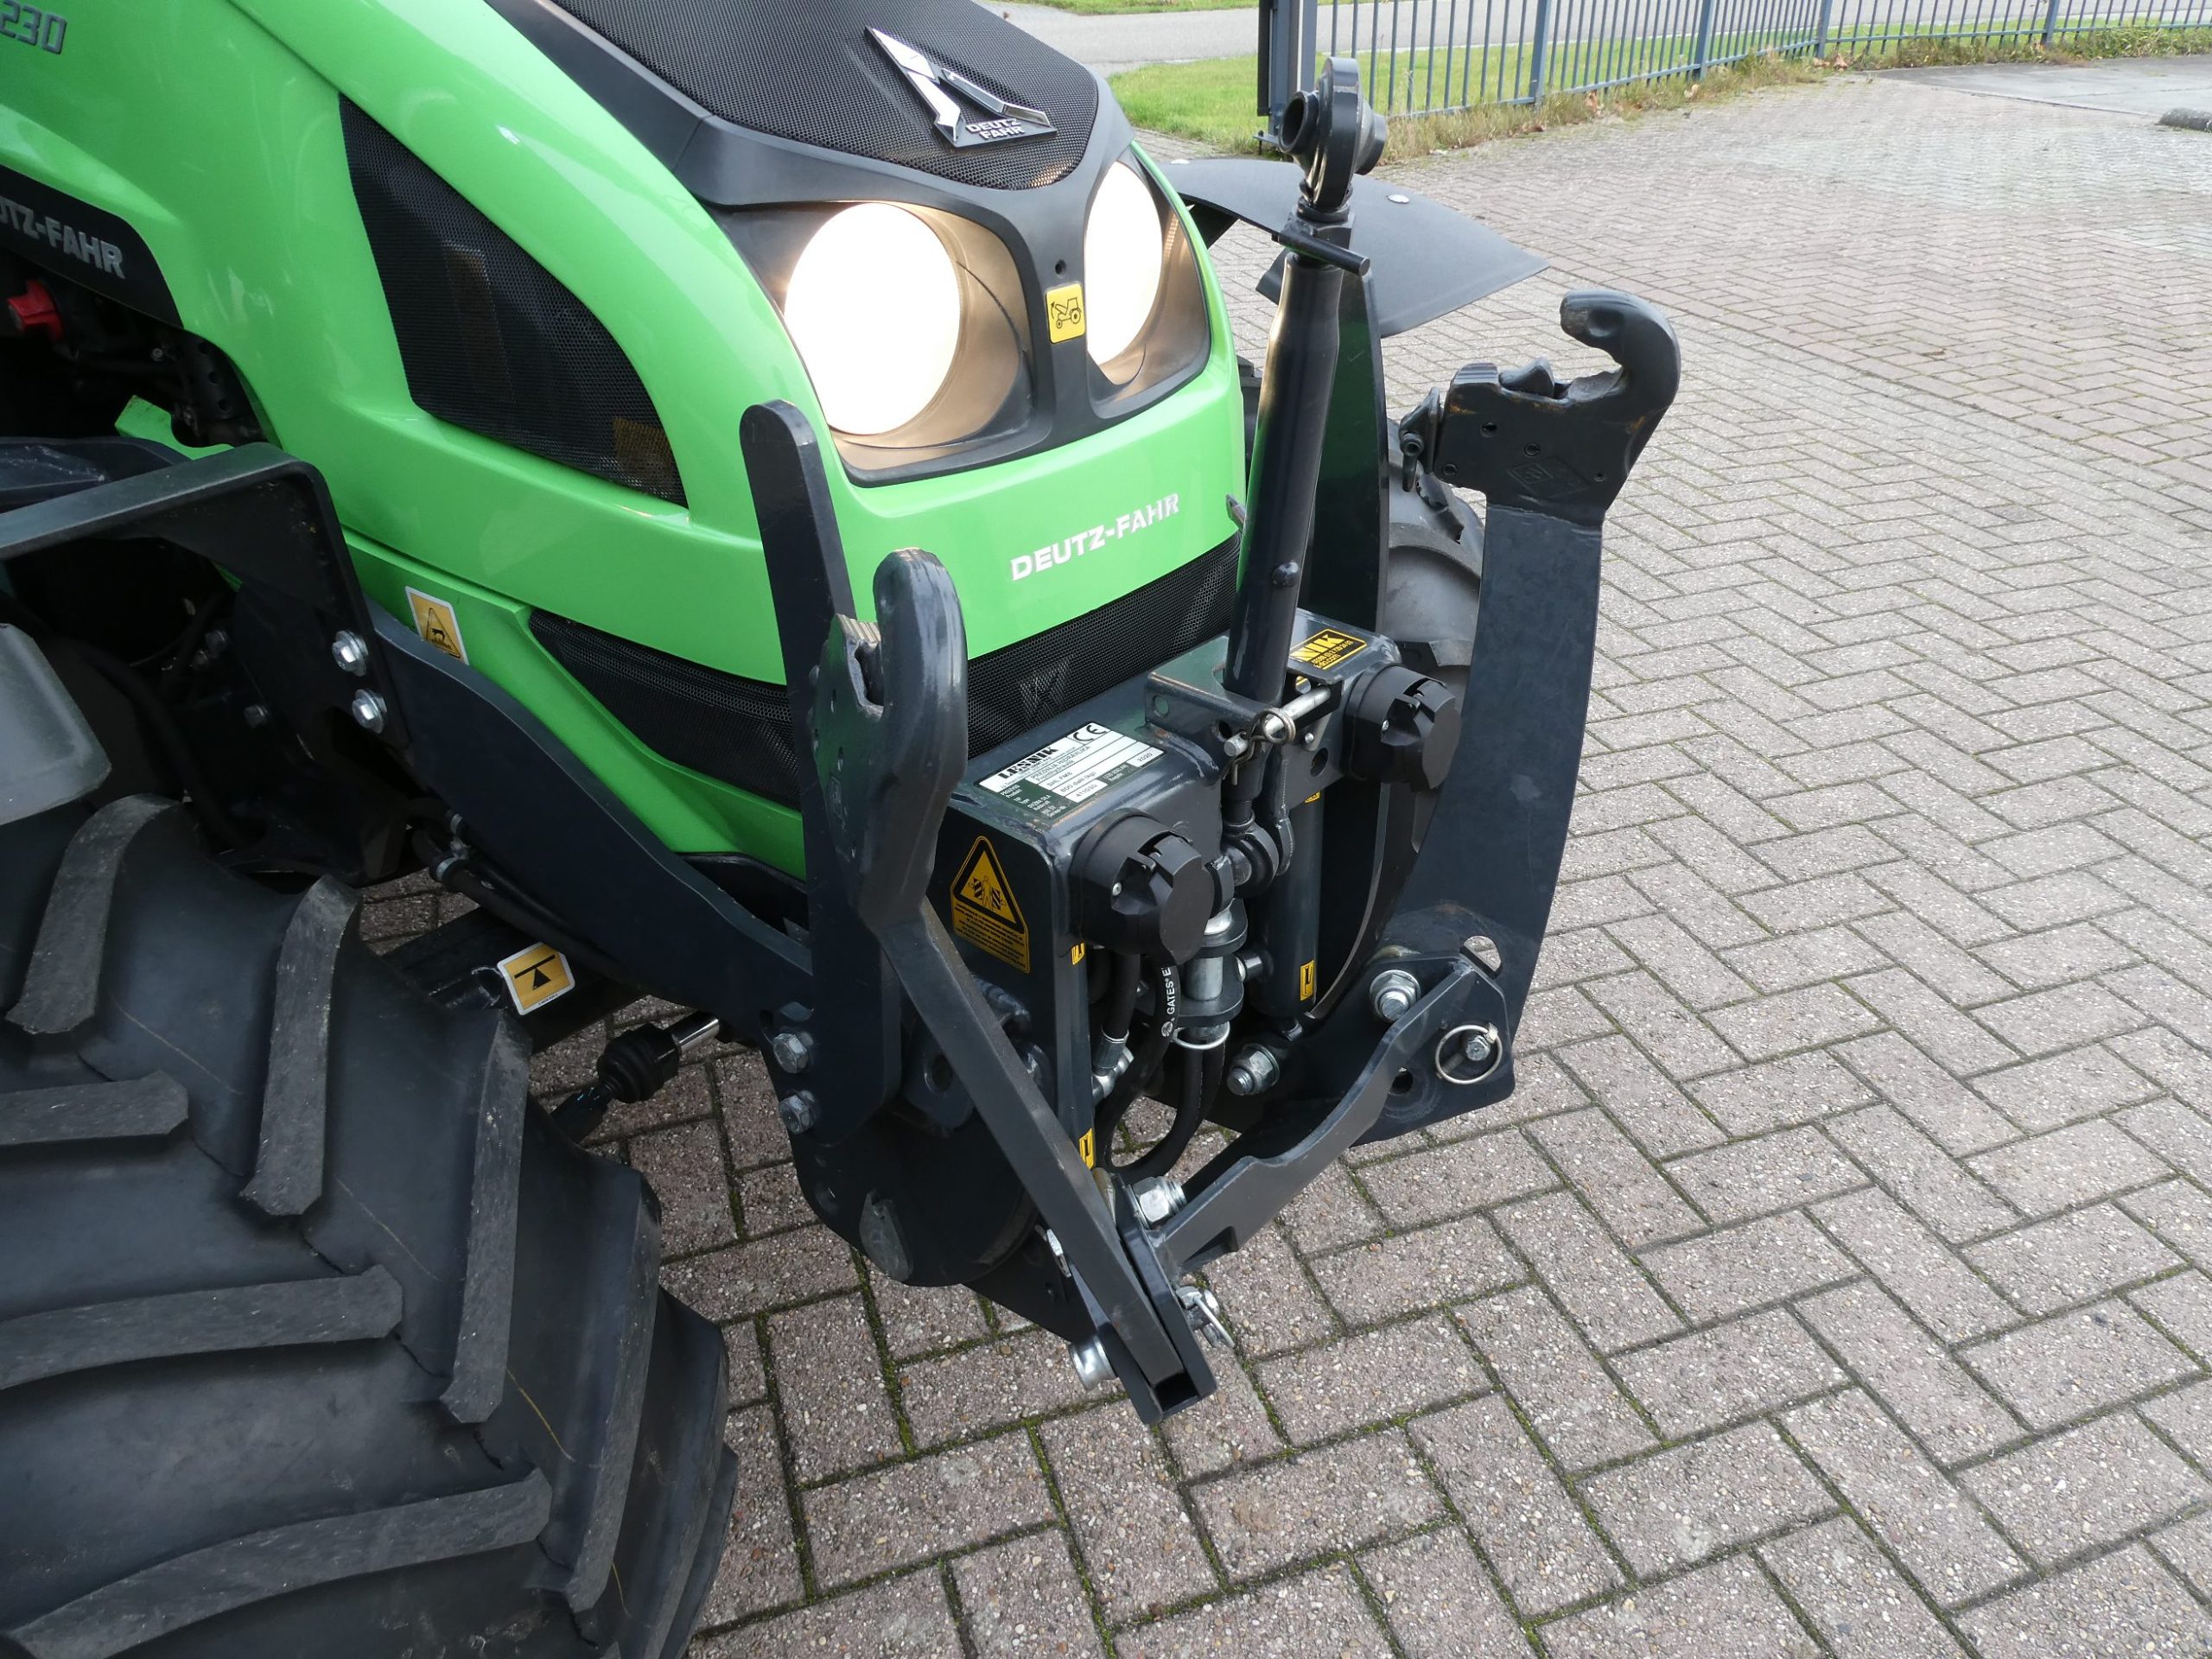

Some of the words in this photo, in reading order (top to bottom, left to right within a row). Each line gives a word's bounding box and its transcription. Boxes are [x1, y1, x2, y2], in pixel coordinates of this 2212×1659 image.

[965, 118, 1021, 133] DEUTZ
[979, 127, 1026, 140] FAHR
[1010, 493, 1179, 581] DEUTZ-FAHR
[1161, 967, 1172, 977] E
[1166, 981, 1176, 1014] GATES
